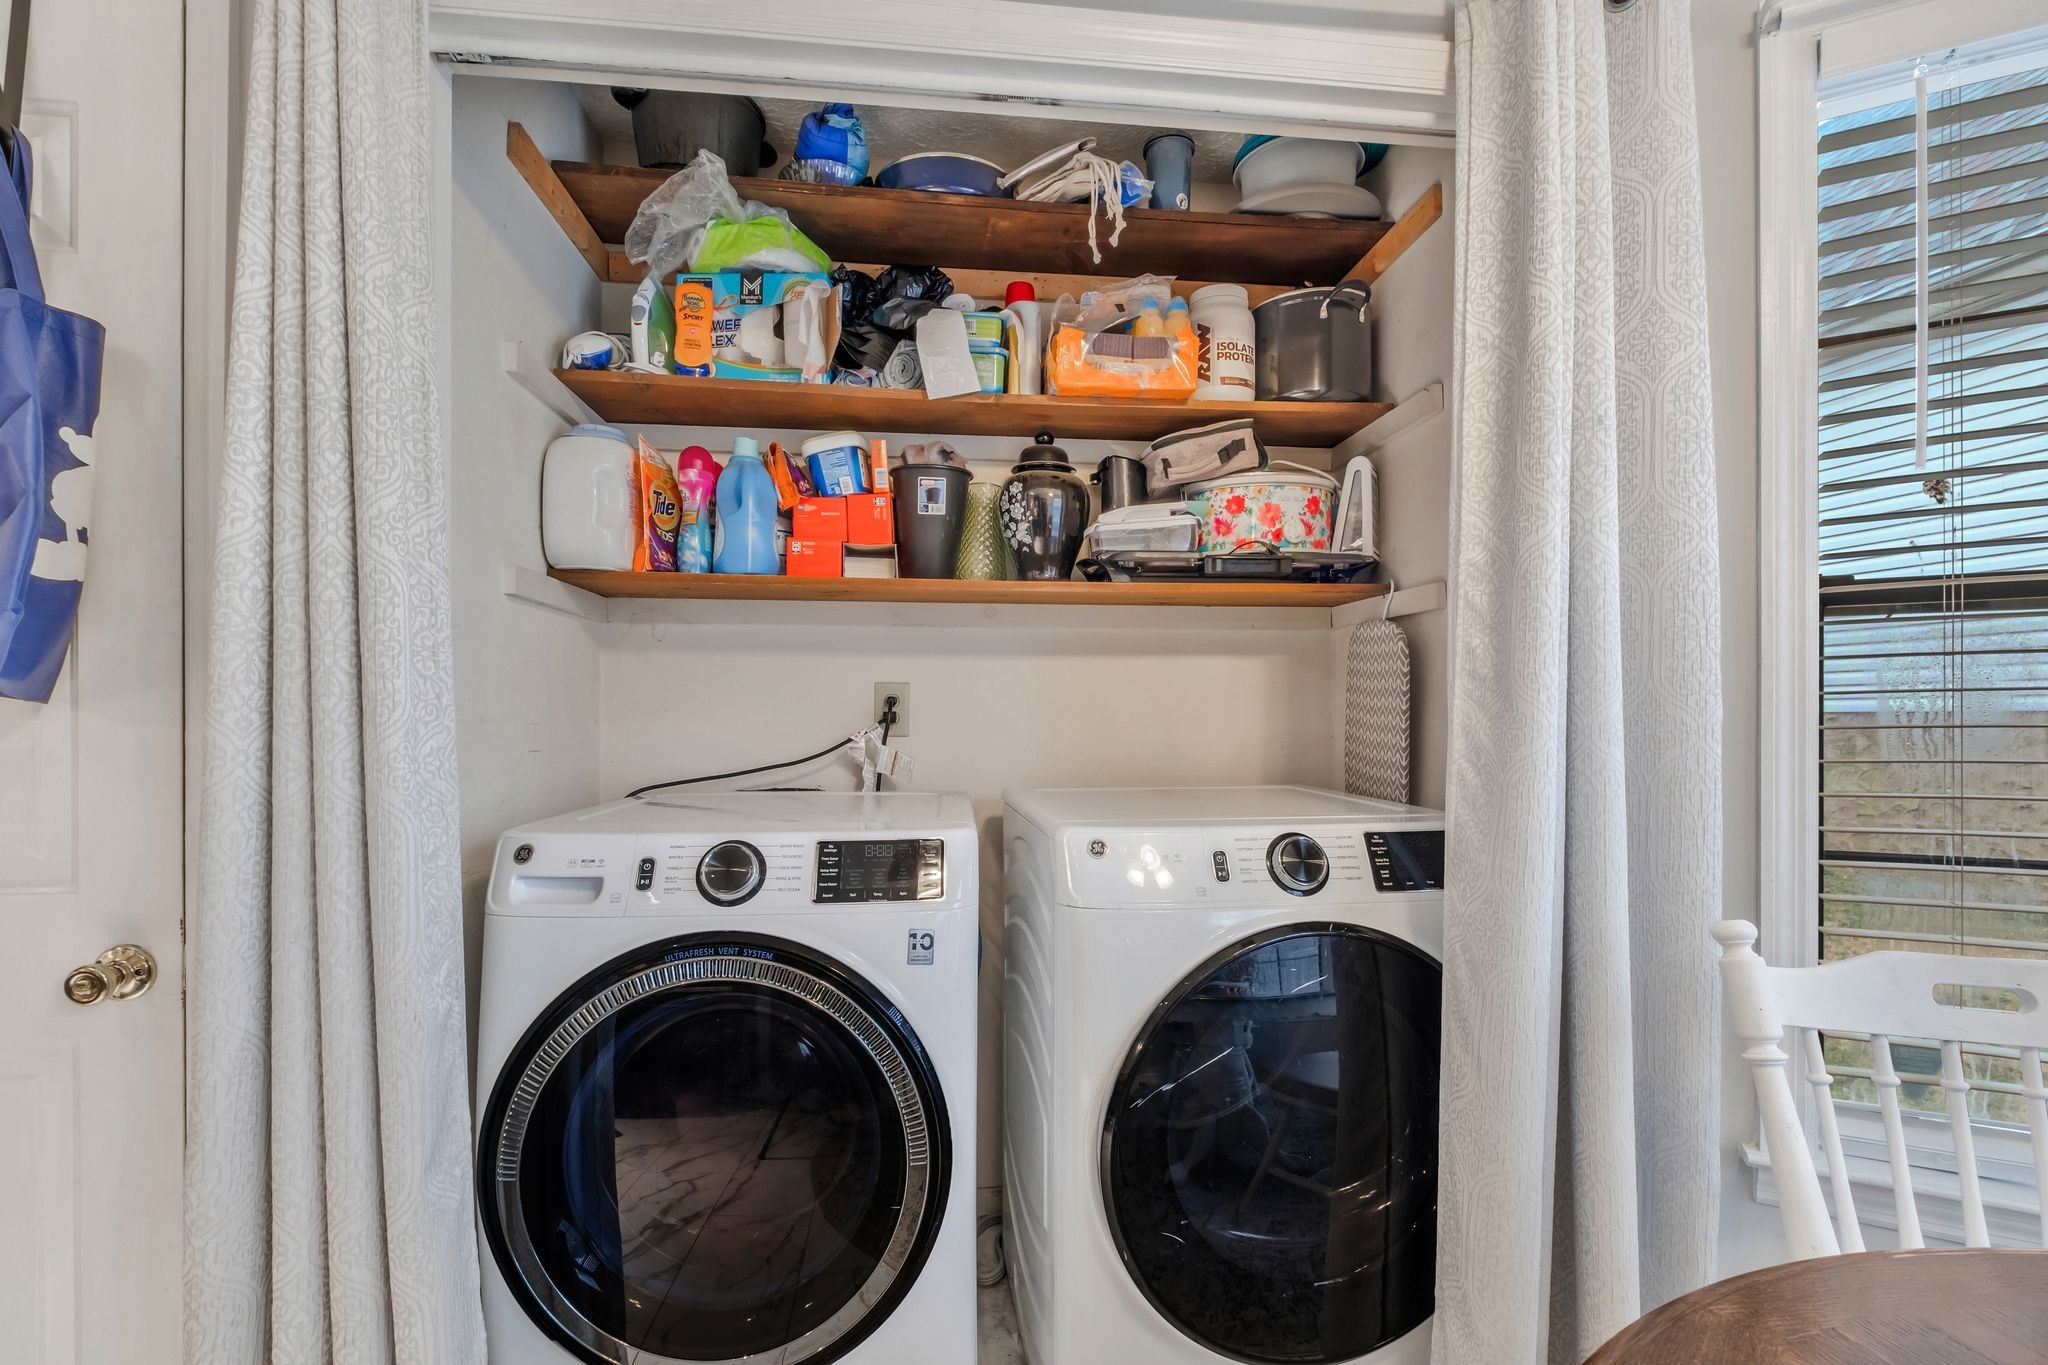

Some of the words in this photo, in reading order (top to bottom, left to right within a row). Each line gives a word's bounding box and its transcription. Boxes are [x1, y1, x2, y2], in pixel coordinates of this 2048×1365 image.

[683, 312, 704, 321] SPORT
[711, 318, 742, 333] WER
[1197, 322, 1211, 383] RAW
[1216, 341, 1255, 357] ISOLATE
[653, 489, 676, 516] Tide
[909, 932, 934, 951] 10
[664, 947, 715, 962] ULTRAFRESH
[718, 947, 740, 956] VENT
[743, 948, 774, 961] SYSTEM
